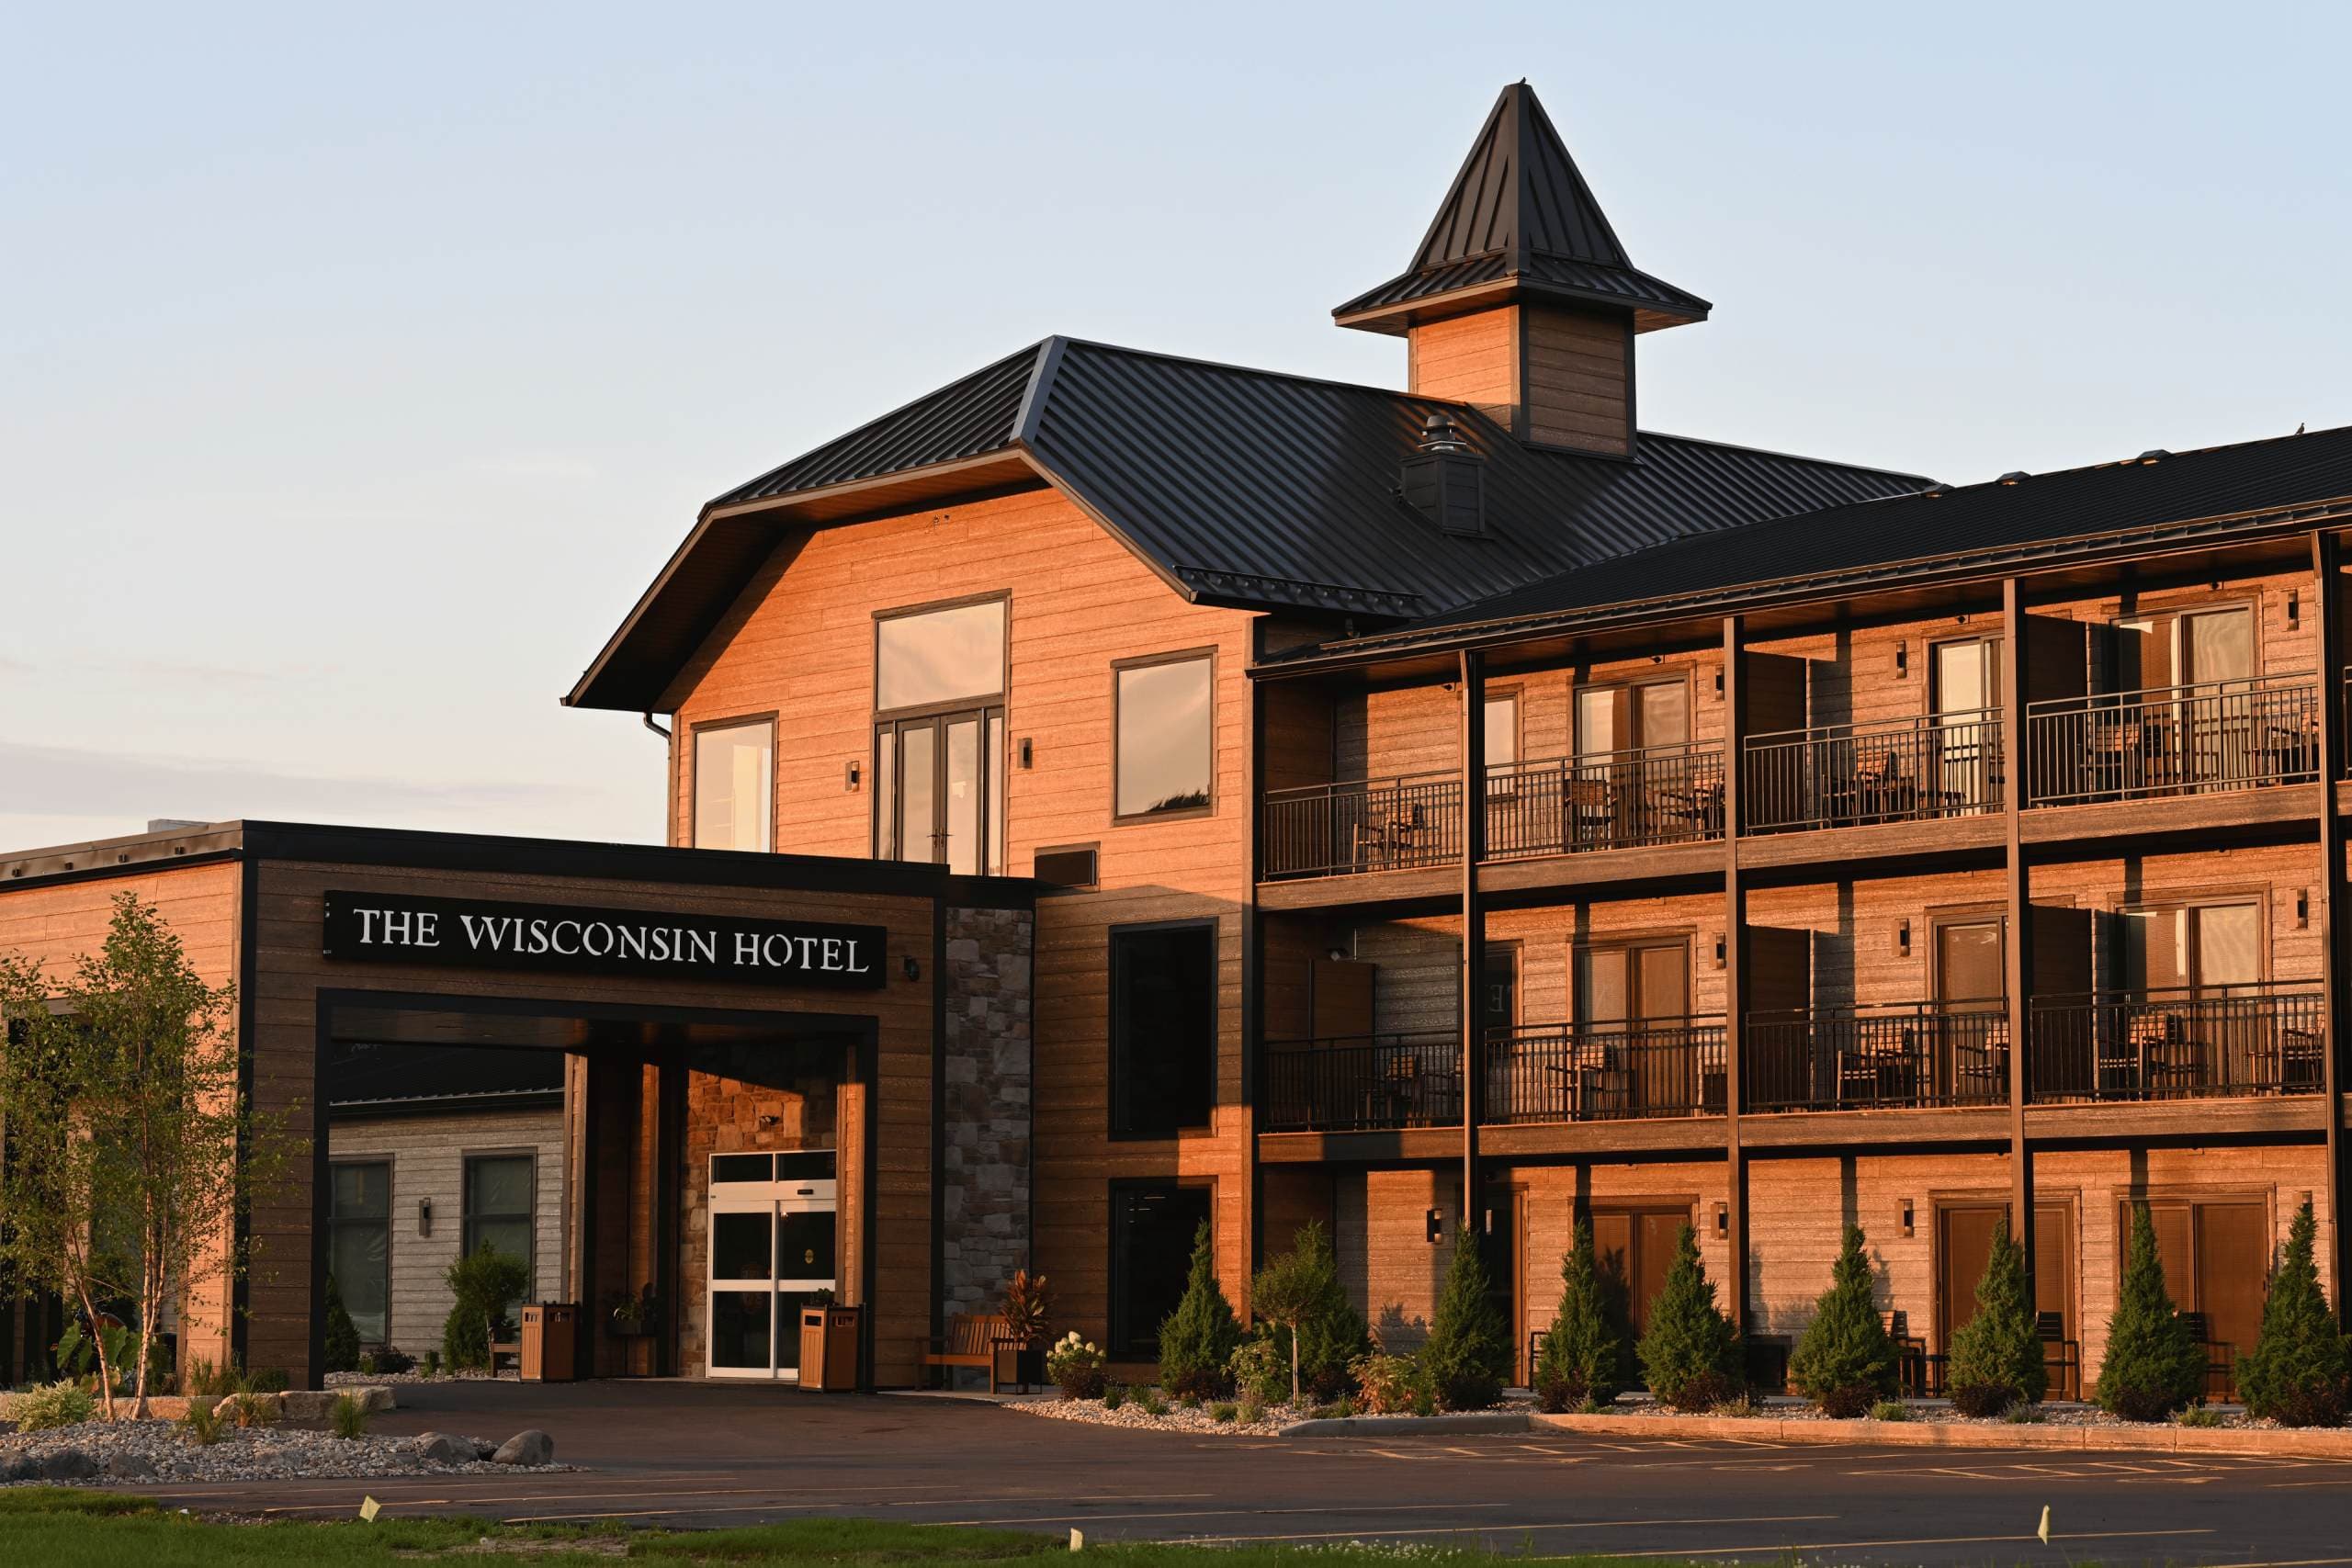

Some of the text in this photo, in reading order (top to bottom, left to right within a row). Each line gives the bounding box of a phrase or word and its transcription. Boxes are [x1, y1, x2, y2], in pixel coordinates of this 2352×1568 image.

[353, 908, 869, 973] THE WISCONSIN HOTEL
